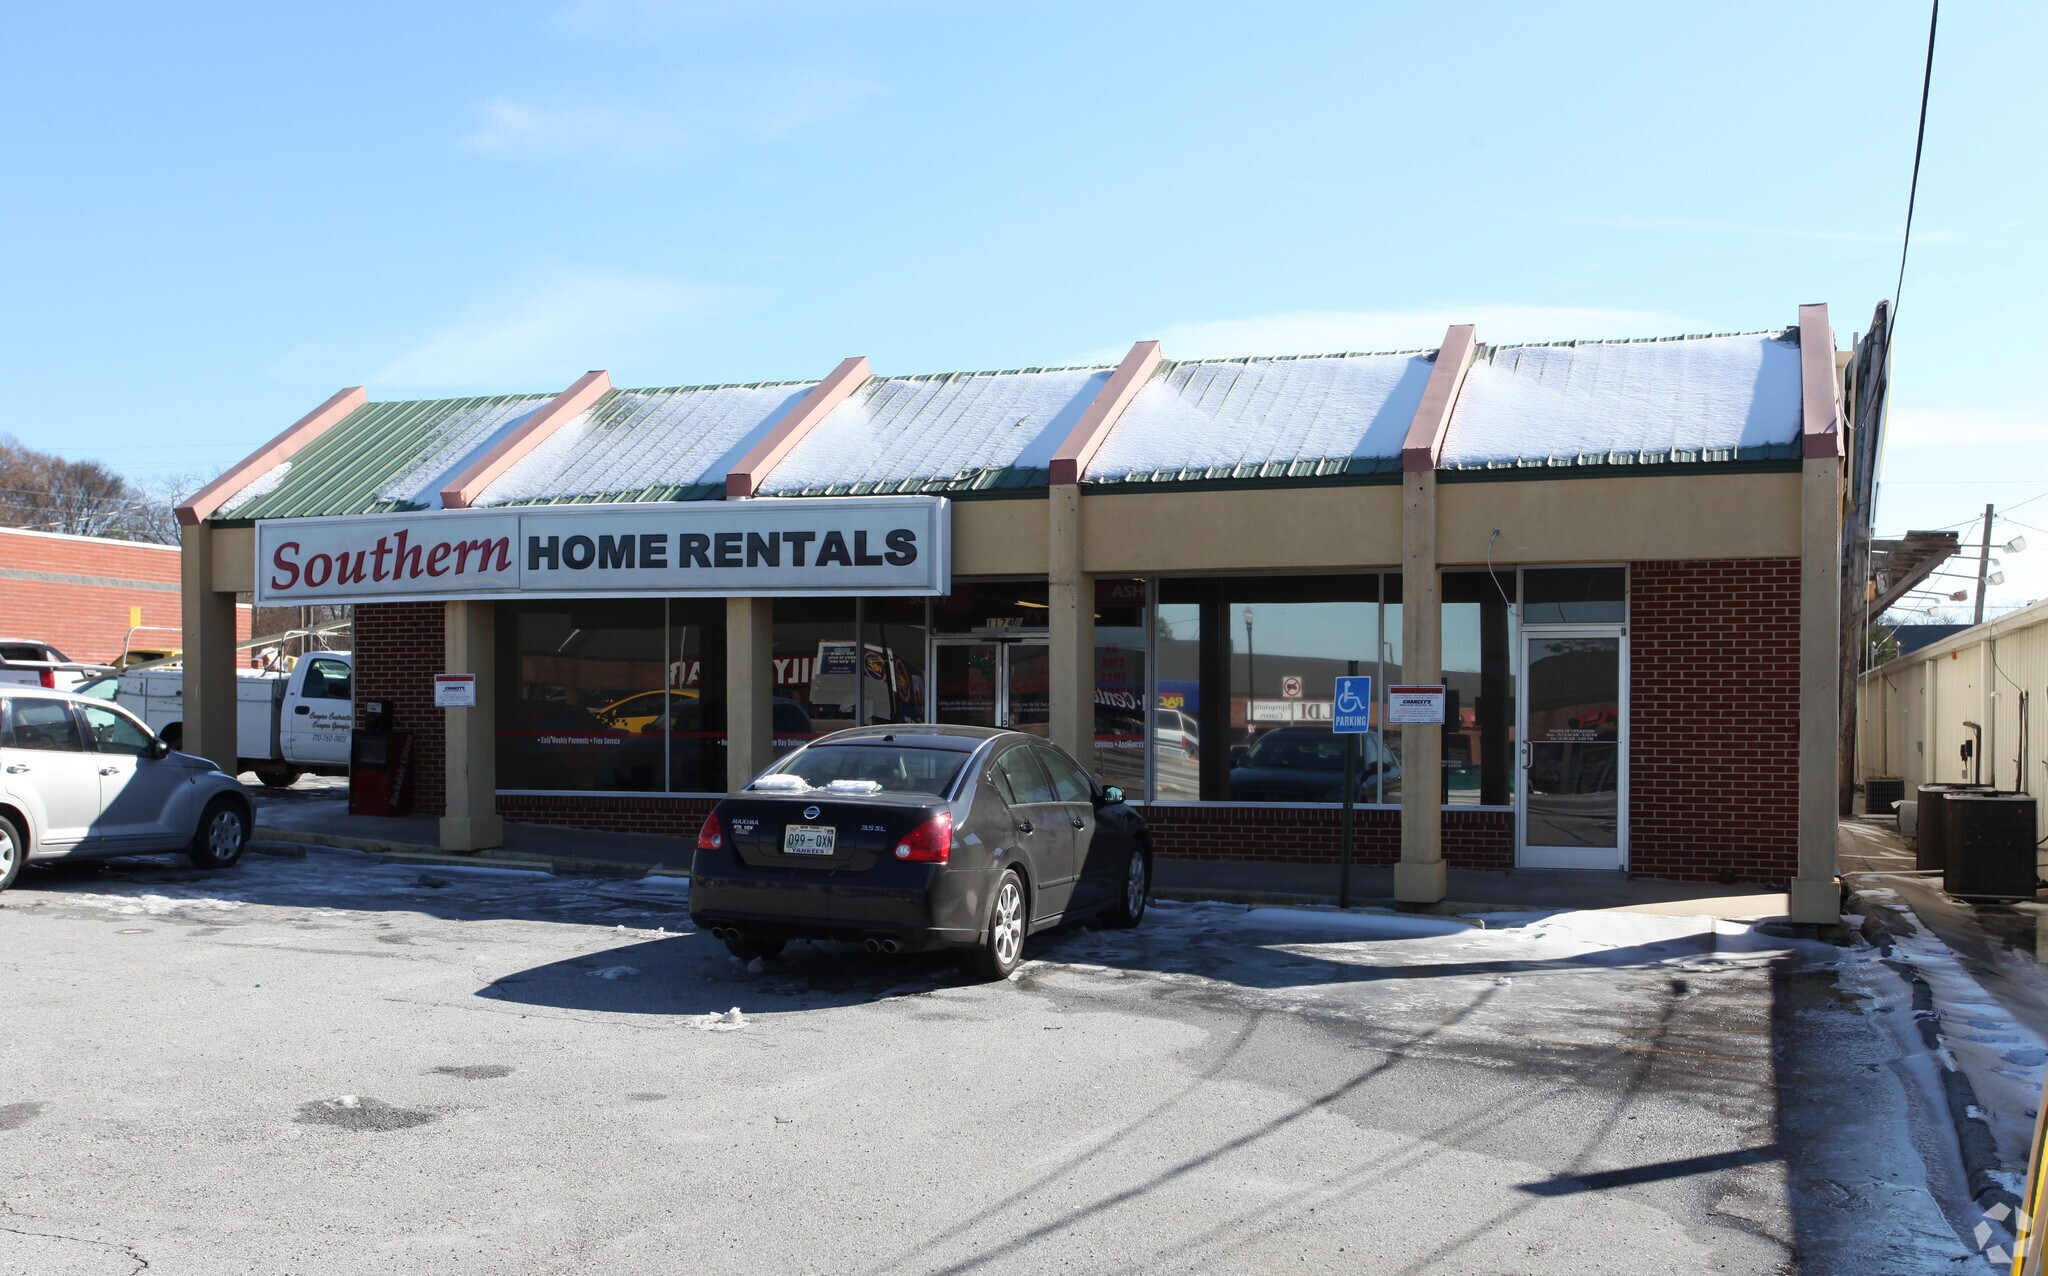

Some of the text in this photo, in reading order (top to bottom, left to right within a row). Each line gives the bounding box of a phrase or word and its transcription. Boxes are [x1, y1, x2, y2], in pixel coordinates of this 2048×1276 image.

[271, 528, 513, 591] Southern
[528, 529, 918, 571] HOME RENTALS
[1335, 716, 1366, 726] PARKING
[568, 737, 589, 745] Payments
[603, 737, 620, 745] Service
